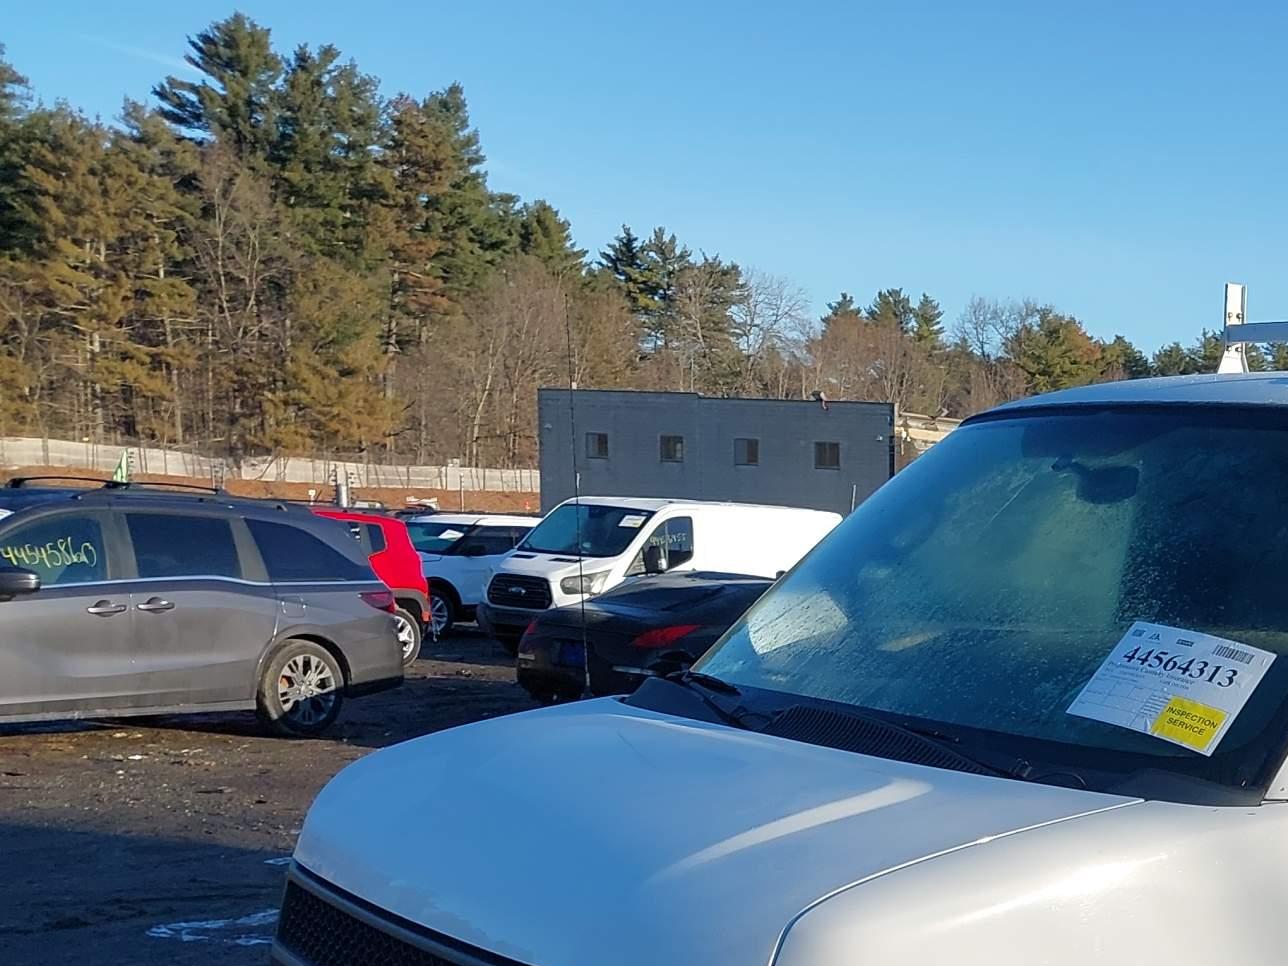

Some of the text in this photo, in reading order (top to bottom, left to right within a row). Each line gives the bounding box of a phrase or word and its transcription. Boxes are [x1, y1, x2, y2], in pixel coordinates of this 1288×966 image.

[1123, 646, 1238, 688] 44564313
[1166, 706, 1218, 729] INSPECTION
[1167, 718, 1205, 736] SERVICE
